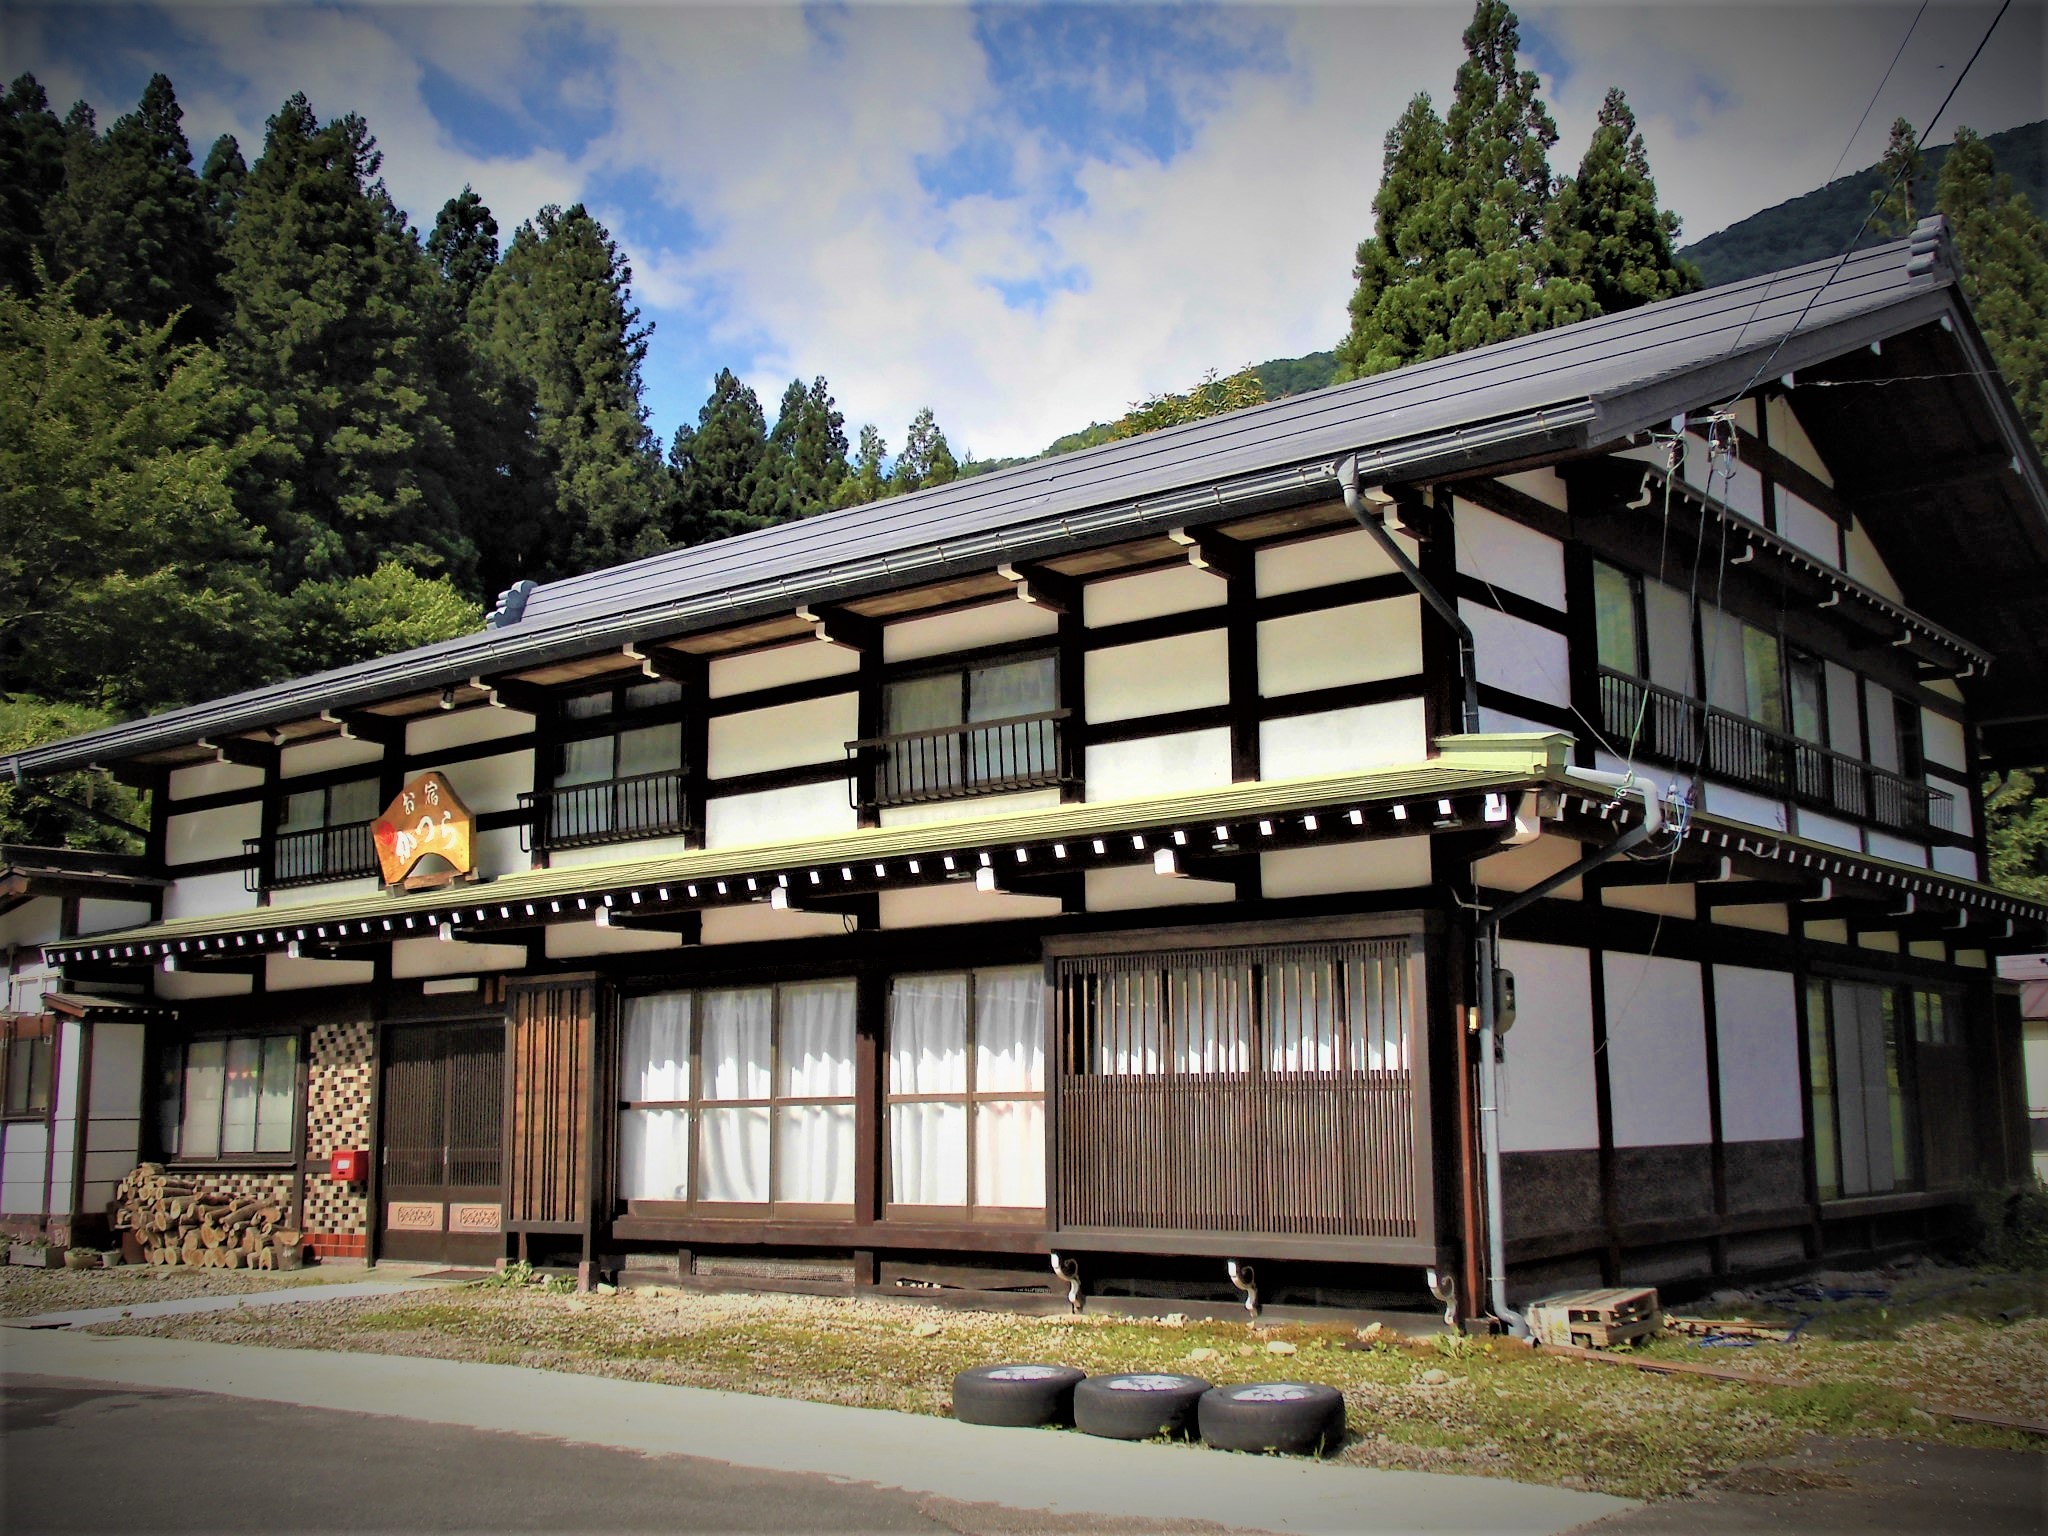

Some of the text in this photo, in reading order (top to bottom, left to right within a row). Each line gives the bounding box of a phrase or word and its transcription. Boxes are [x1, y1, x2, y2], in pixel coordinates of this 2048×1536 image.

[402, 781, 439, 815] お宿
[395, 810, 457, 865] かつら
